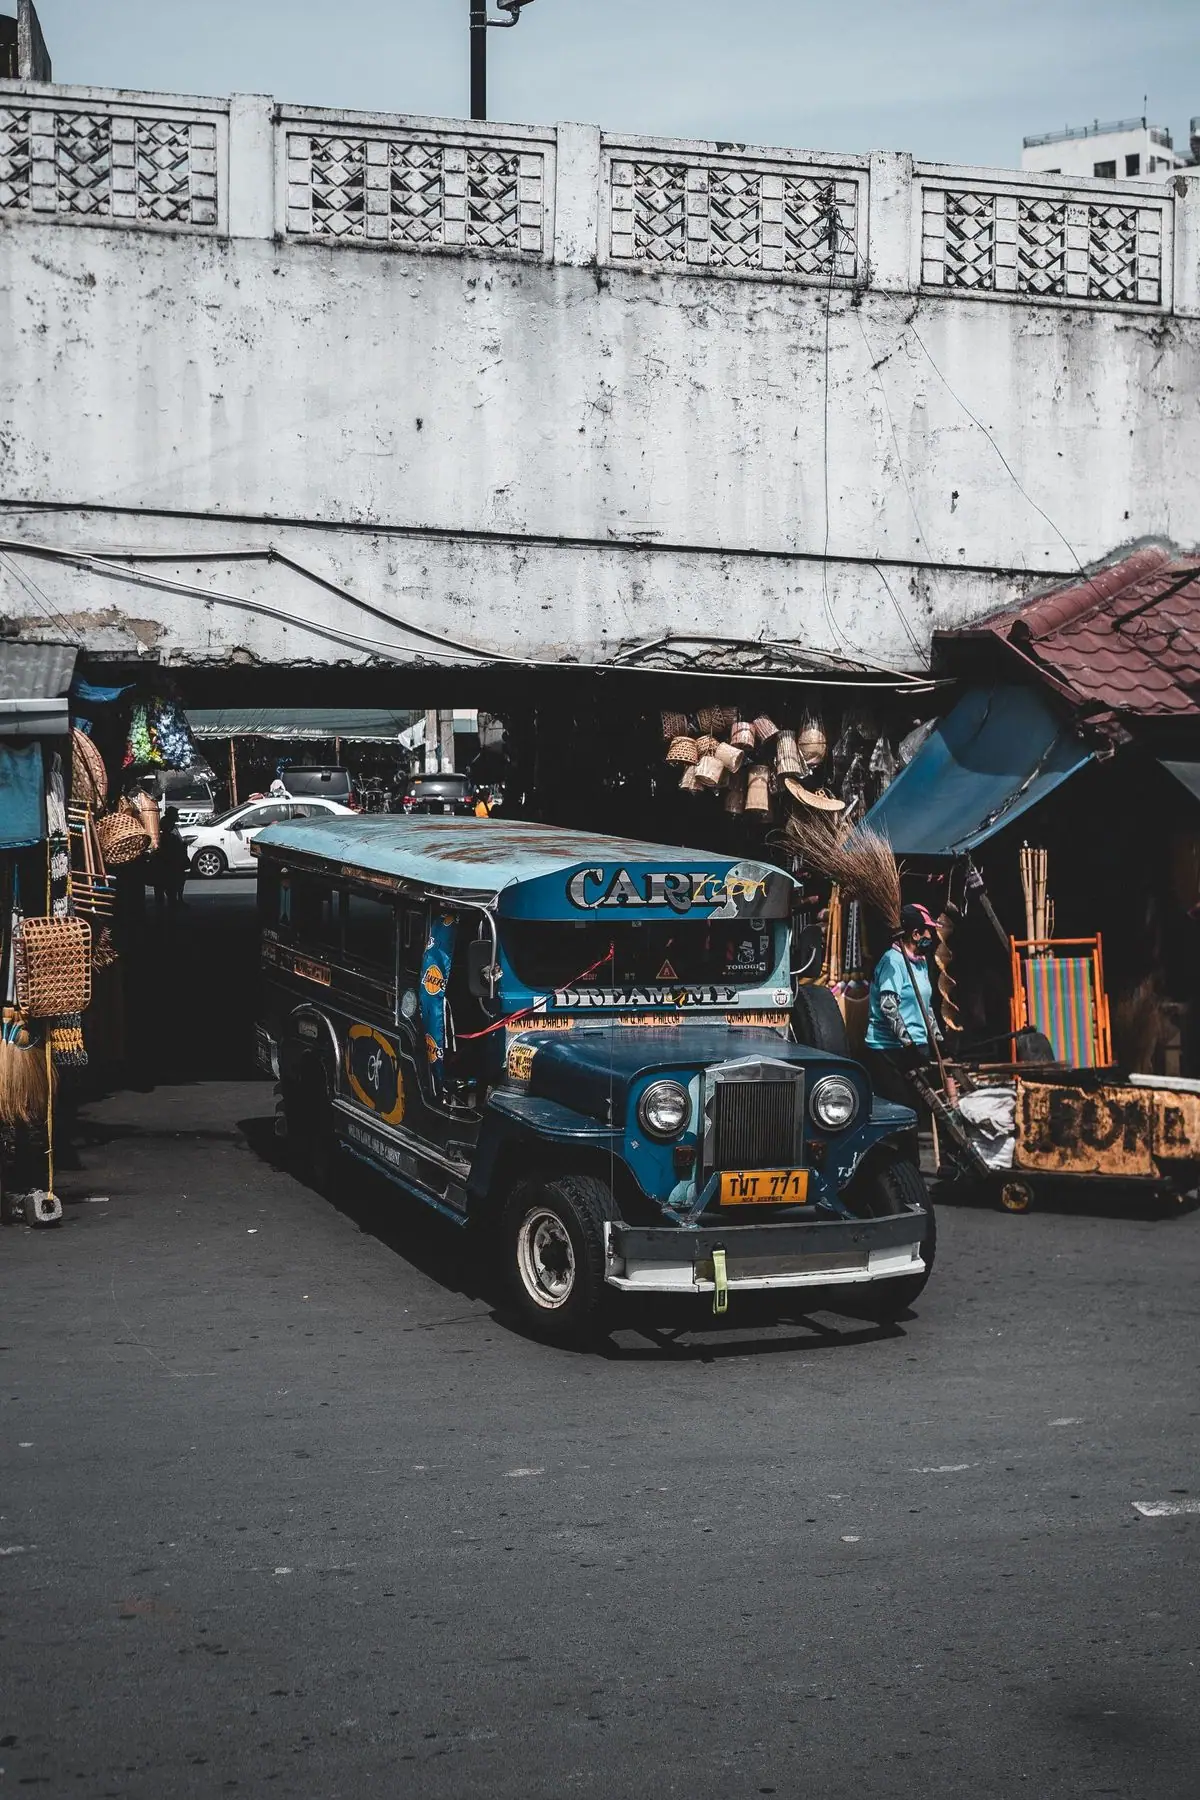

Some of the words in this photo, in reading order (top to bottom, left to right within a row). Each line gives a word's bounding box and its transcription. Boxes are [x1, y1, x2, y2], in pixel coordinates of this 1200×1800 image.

[569, 867, 727, 912] CARL
[555, 986, 675, 1008] DREAM
[730, 1177, 760, 1197] TWT
[770, 1176, 800, 1195] 771
